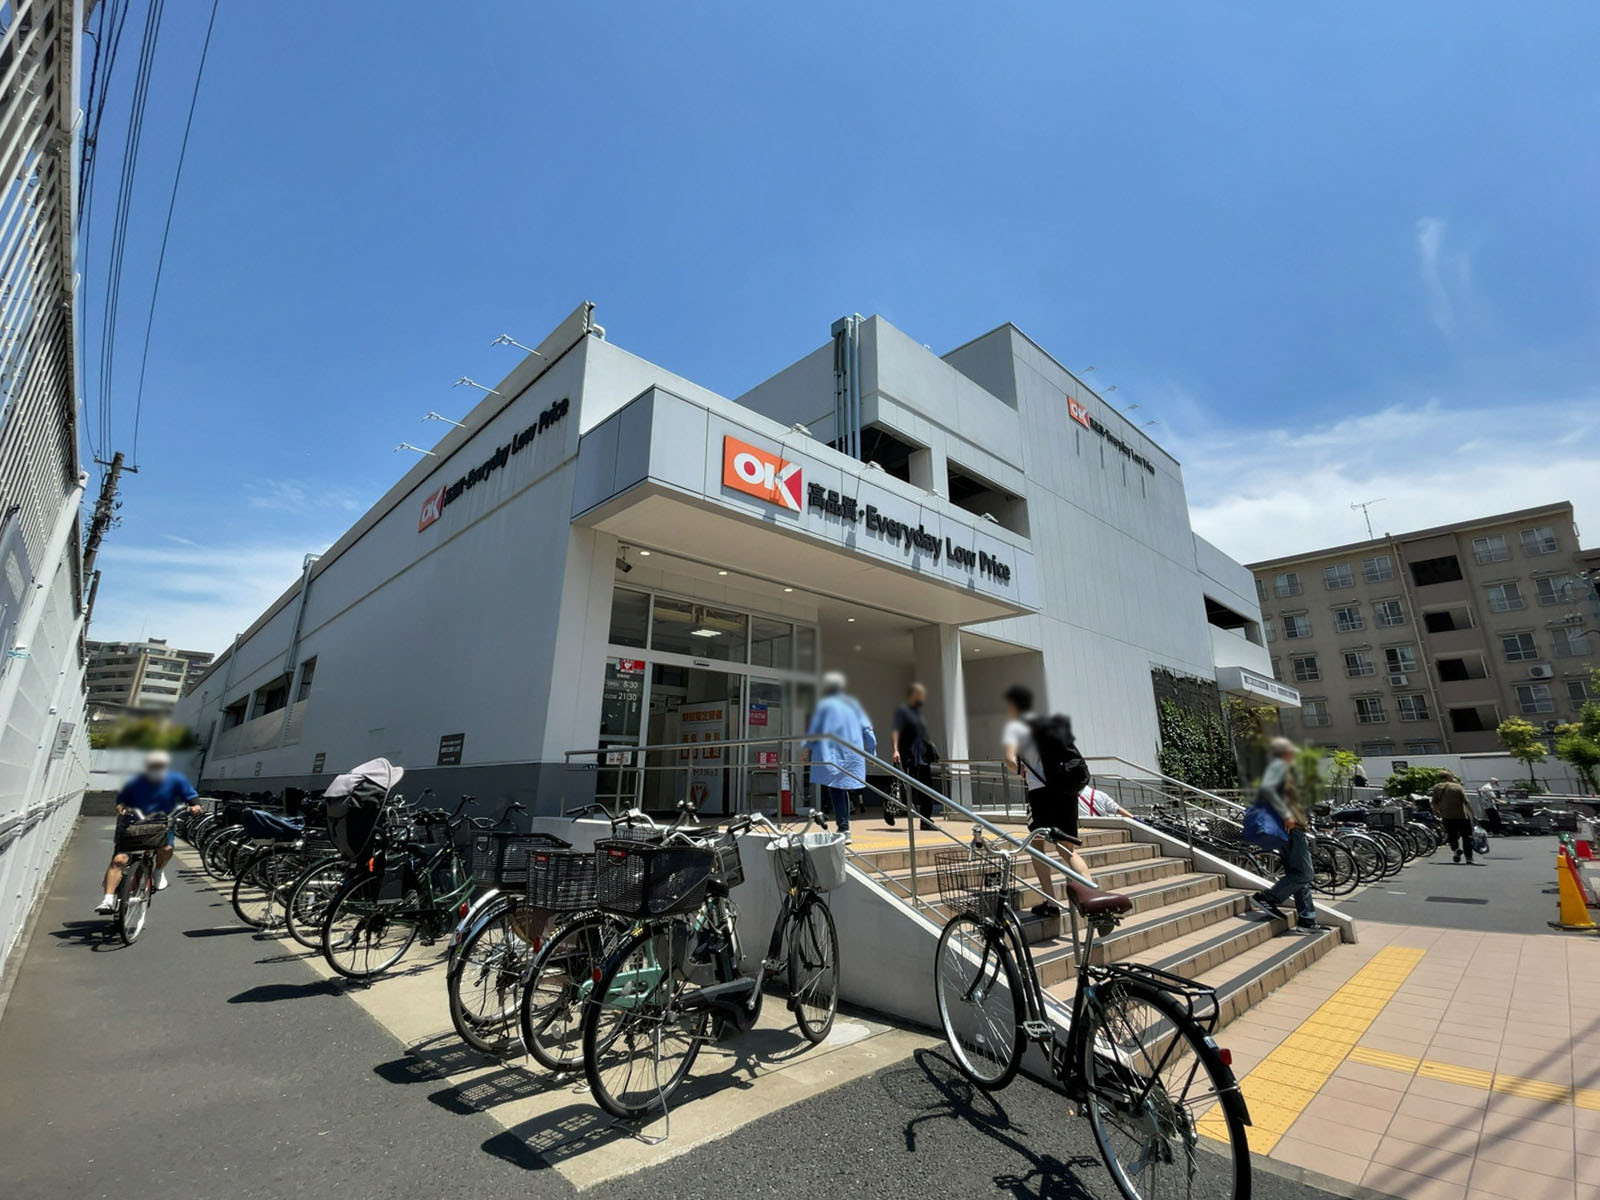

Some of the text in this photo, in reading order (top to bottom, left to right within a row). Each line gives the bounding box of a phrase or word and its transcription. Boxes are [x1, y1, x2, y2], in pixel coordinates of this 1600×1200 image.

[734, 452, 802, 511] OK
[946, 537, 976, 568] Low
[979, 550, 1011, 581] Price
